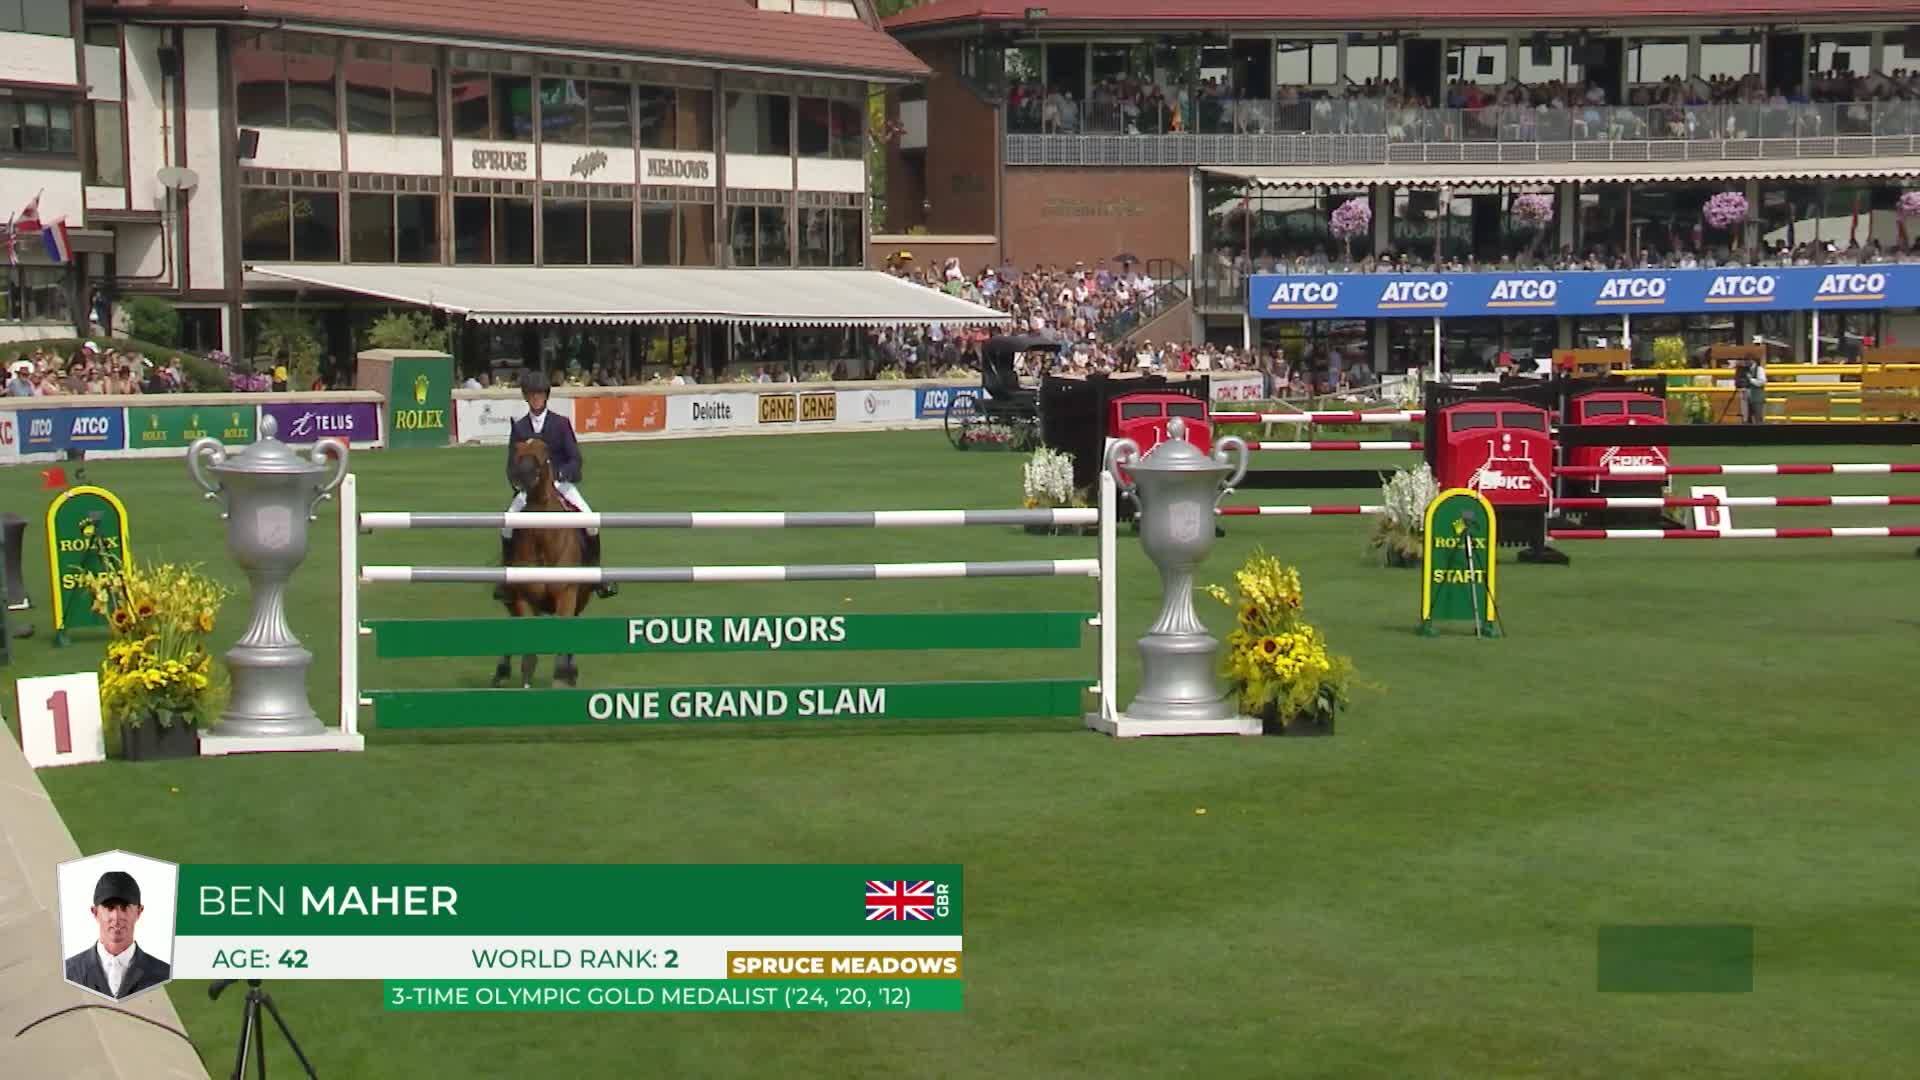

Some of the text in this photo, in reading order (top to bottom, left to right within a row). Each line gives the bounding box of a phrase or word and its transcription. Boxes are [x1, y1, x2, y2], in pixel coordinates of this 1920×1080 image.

[471, 149, 709, 179] SPRUCE MEADOWS
[1272, 282, 1338, 301] ATCO
[1381, 281, 1448, 300] ATCO
[1490, 279, 1556, 299] ATCO
[1600, 277, 1666, 297] ATCO
[1709, 275, 1775, 295] ATCO
[1818, 273, 1885, 293] ATCO
[762, 399, 794, 419] CANA
[803, 398, 834, 417] CANA
[924, 390, 949, 408] ATCO
[72, 417, 109, 434] ATCO
[315, 415, 354, 430] TELUS
[395, 410, 443, 429] ROLEX
[628, 616, 847, 649] FOUR MAJORS
[587, 687, 886, 720] ONE GRAND SLAM
[46, 690, 73, 755] 1
